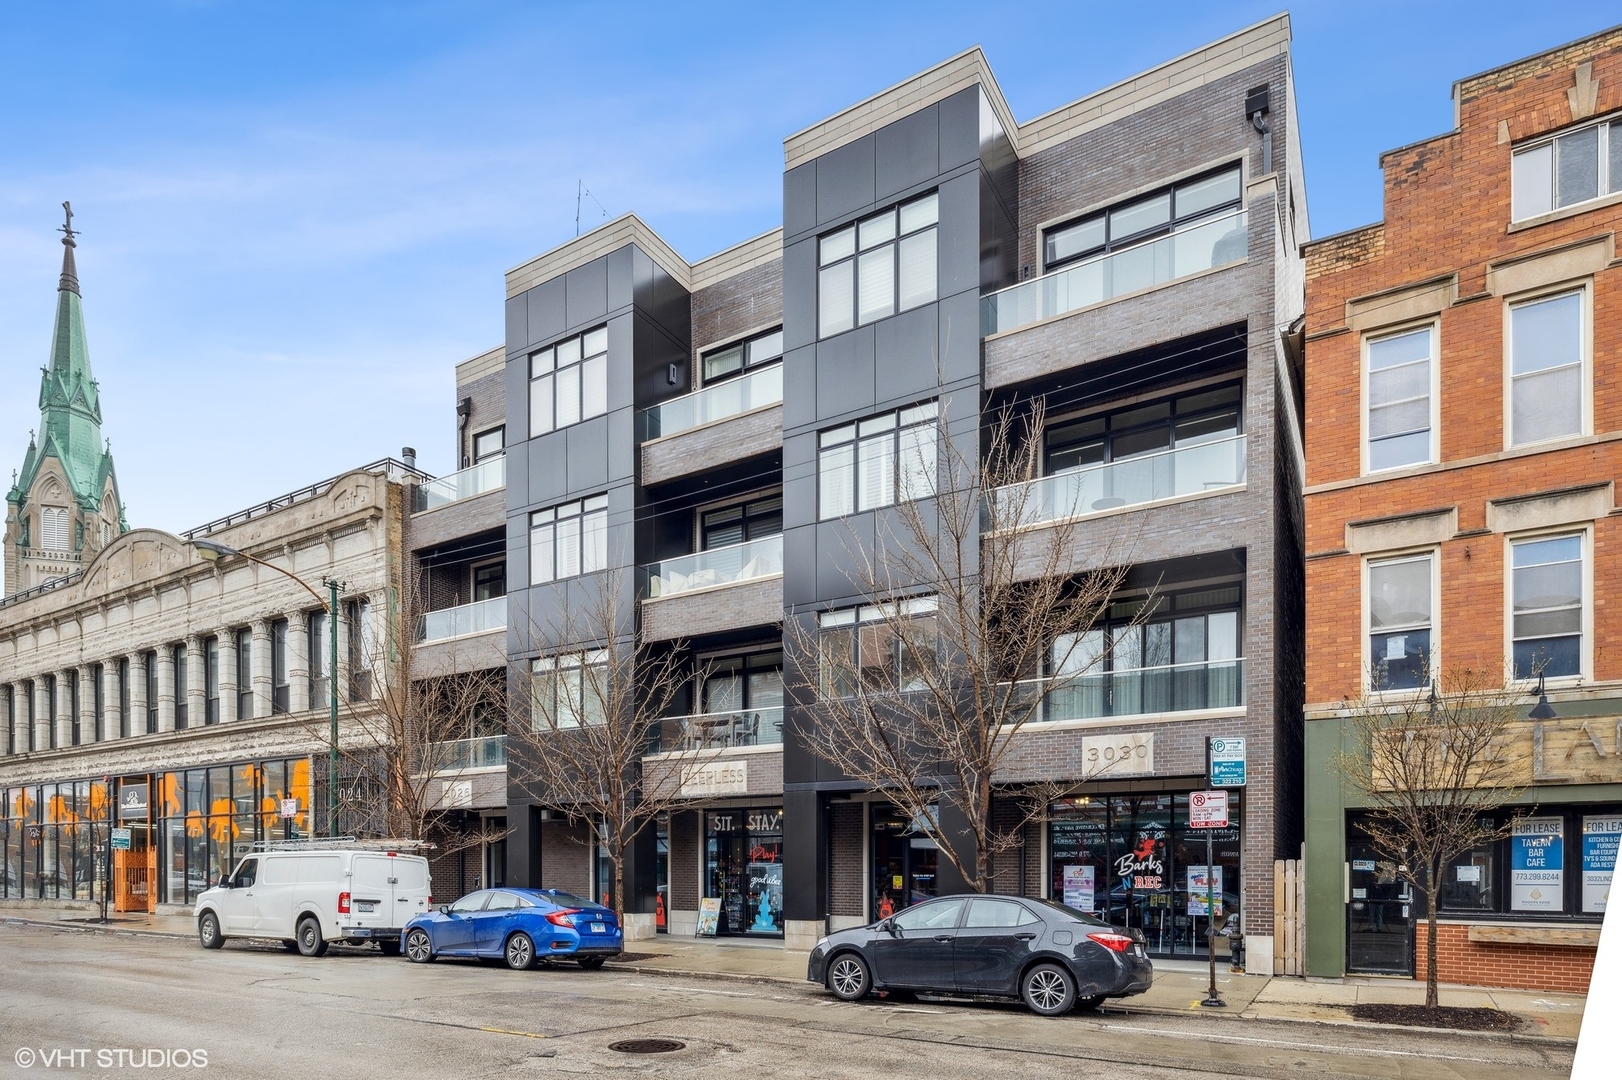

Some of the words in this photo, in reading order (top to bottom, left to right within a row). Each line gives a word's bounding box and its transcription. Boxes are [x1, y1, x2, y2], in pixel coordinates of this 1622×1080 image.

[1087, 744, 1149, 762] 3030
[339, 787, 363, 802] 024
[713, 815, 736, 832] SIT.
[748, 814, 780, 831] STAY.
[1515, 823, 1532, 834] FOR
[1533, 822, 1561, 833] LEASE
[1586, 822, 1604, 832] FOR
[1521, 838, 1551, 847] TAVERN
[749, 843, 779, 864] Play!
[1528, 848, 1544, 857] BAR
[1114, 853, 1163, 876] Barks
[1526, 858, 1546, 867] CAFE
[750, 873, 767, 889] good
[1134, 875, 1162, 889] REC
[1194, 877, 1219, 886] PLY
[1515, 872, 1559, 881] 773.299.8244
